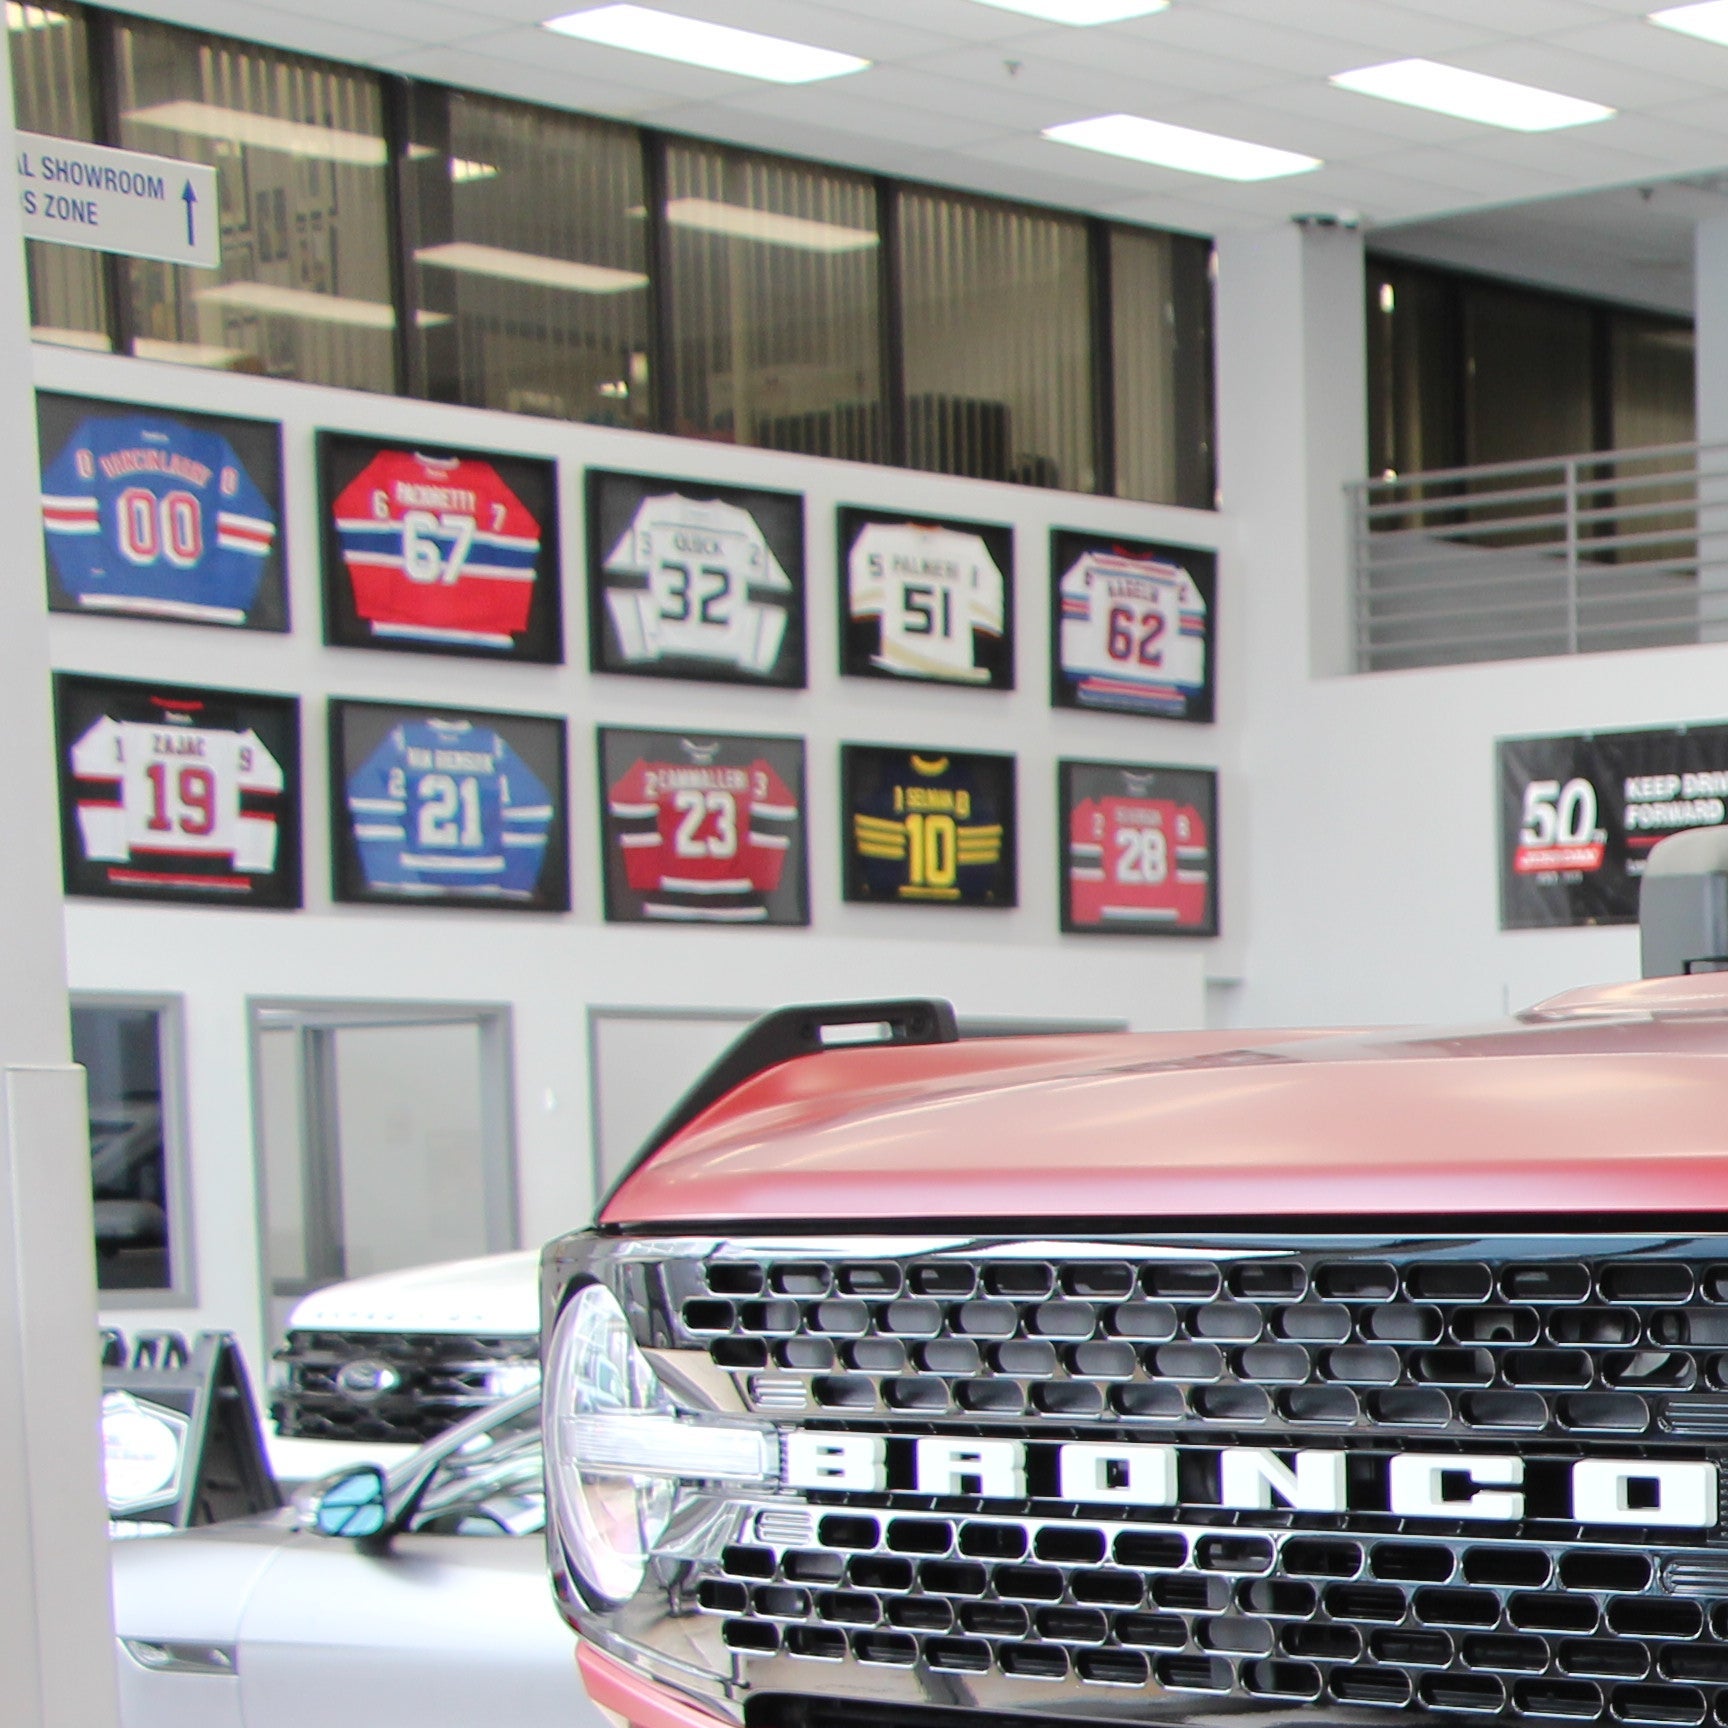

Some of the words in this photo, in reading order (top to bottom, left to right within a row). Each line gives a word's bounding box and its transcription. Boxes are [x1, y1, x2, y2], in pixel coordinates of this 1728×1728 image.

[17, 152, 35, 177] L
[41, 155, 165, 200] SHOWROOM
[44, 193, 99, 226] ZONE
[117, 487, 203, 568] 00
[403, 510, 477, 584] 67
[660, 560, 731, 625] 32
[904, 584, 951, 637] 51
[1109, 605, 1165, 667] 62
[153, 733, 207, 757] ZAJAC
[148, 762, 216, 836] 19
[418, 774, 485, 848] 21
[1519, 777, 1598, 846] 50
[1624, 773, 1681, 803] KEEP
[1624, 797, 1726, 830] FORWARD
[675, 789, 738, 860] 23
[905, 814, 957, 888] 10
[1115, 827, 1168, 885] 28
[782, 1431, 1718, 1529] BRONCO
